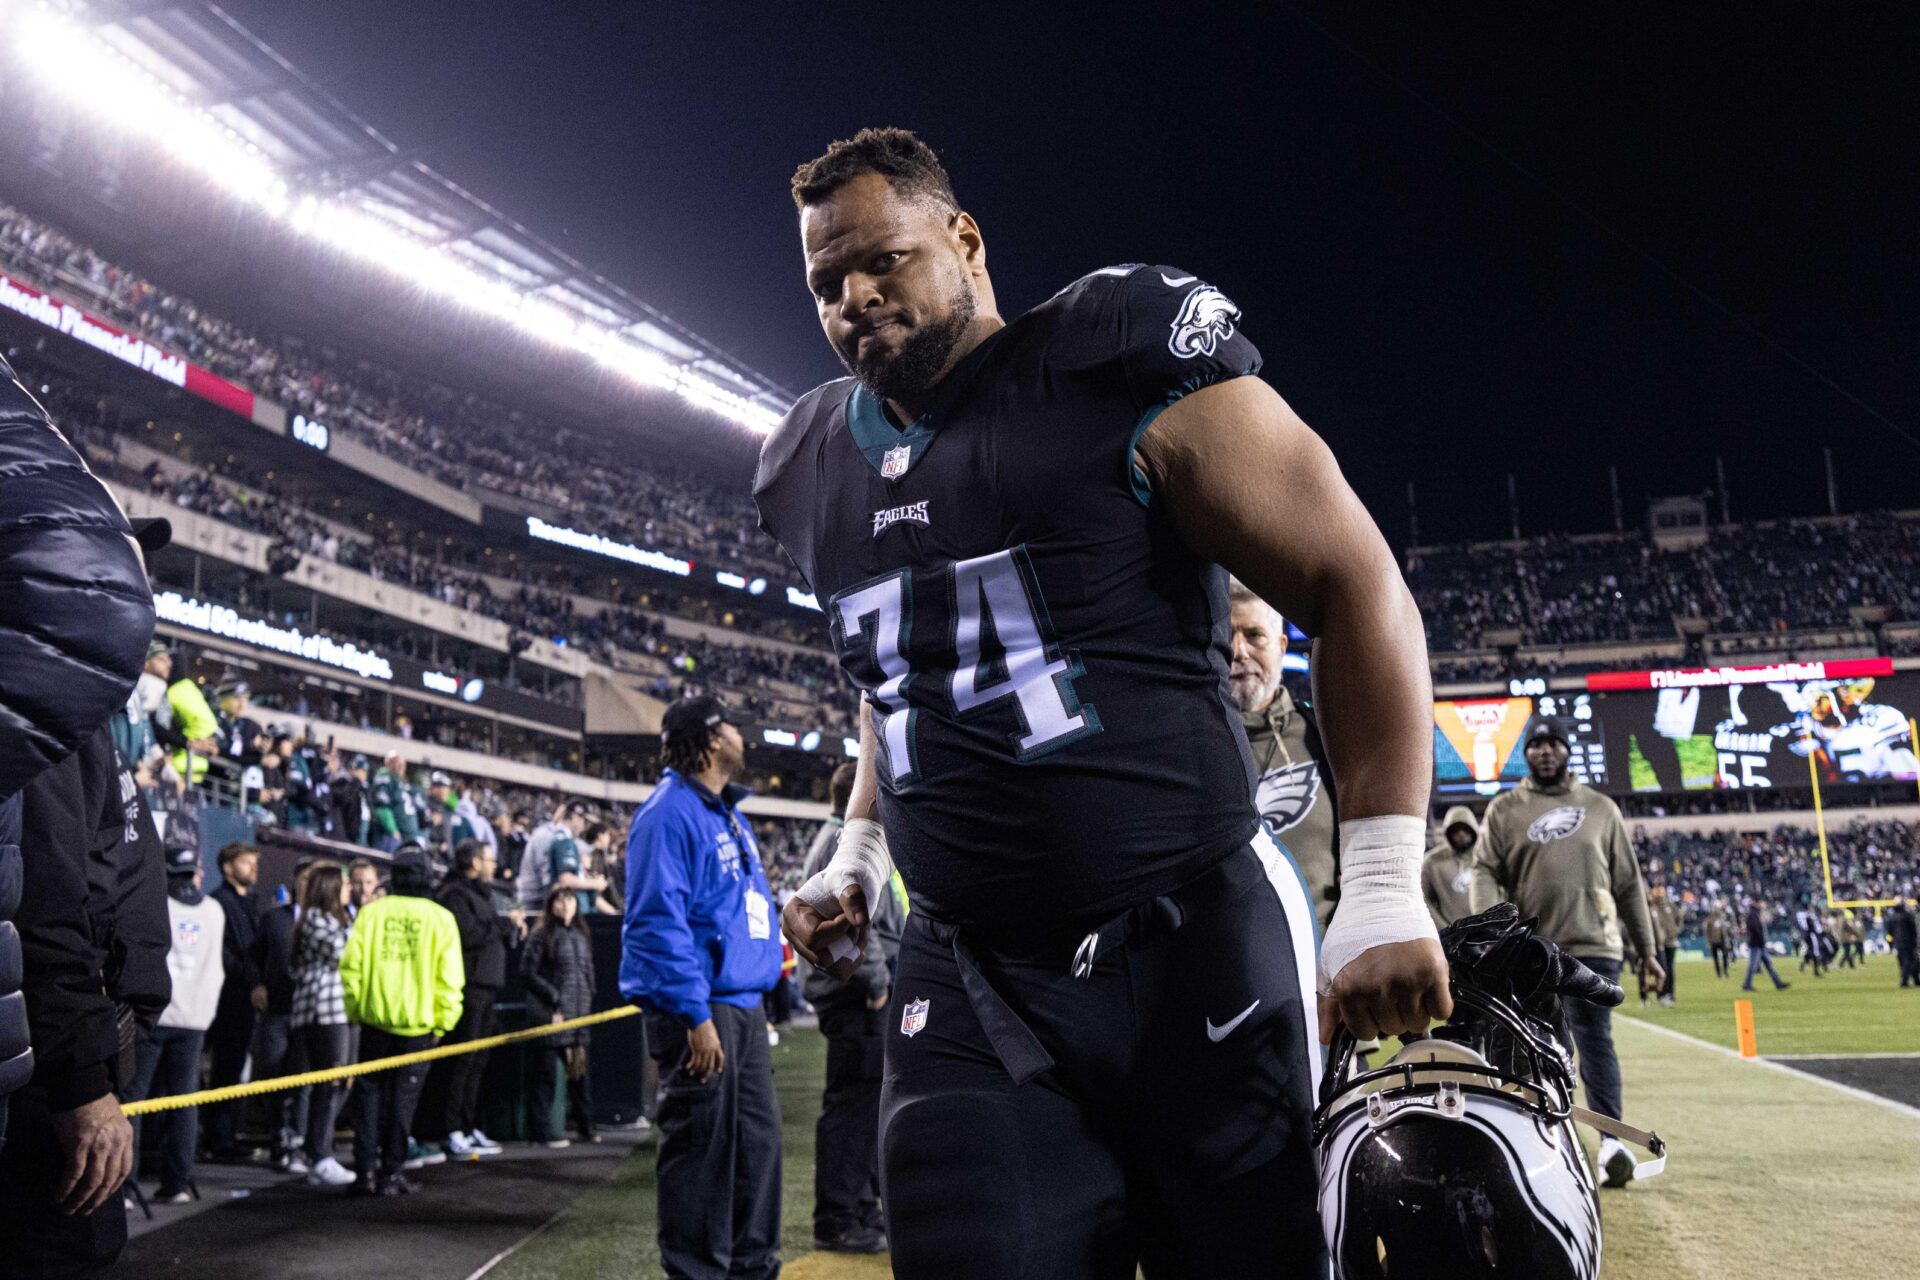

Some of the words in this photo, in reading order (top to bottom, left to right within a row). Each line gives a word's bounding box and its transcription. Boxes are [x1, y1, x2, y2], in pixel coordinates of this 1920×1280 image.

[0, 276, 61, 330] incoln
[143, 343, 187, 388] Field
[873, 500, 931, 537] EAGLES
[237, 618, 303, 656] network
[302, 633, 320, 660] of
[319, 637, 343, 667] the
[832, 546, 1097, 782] 74
[1666, 669, 1721, 687] Lincoln
[1719, 663, 1788, 684] Financial
[1786, 661, 1826, 680] Field
[1718, 753, 1771, 789] 55
[383, 916, 422, 934] CSC
